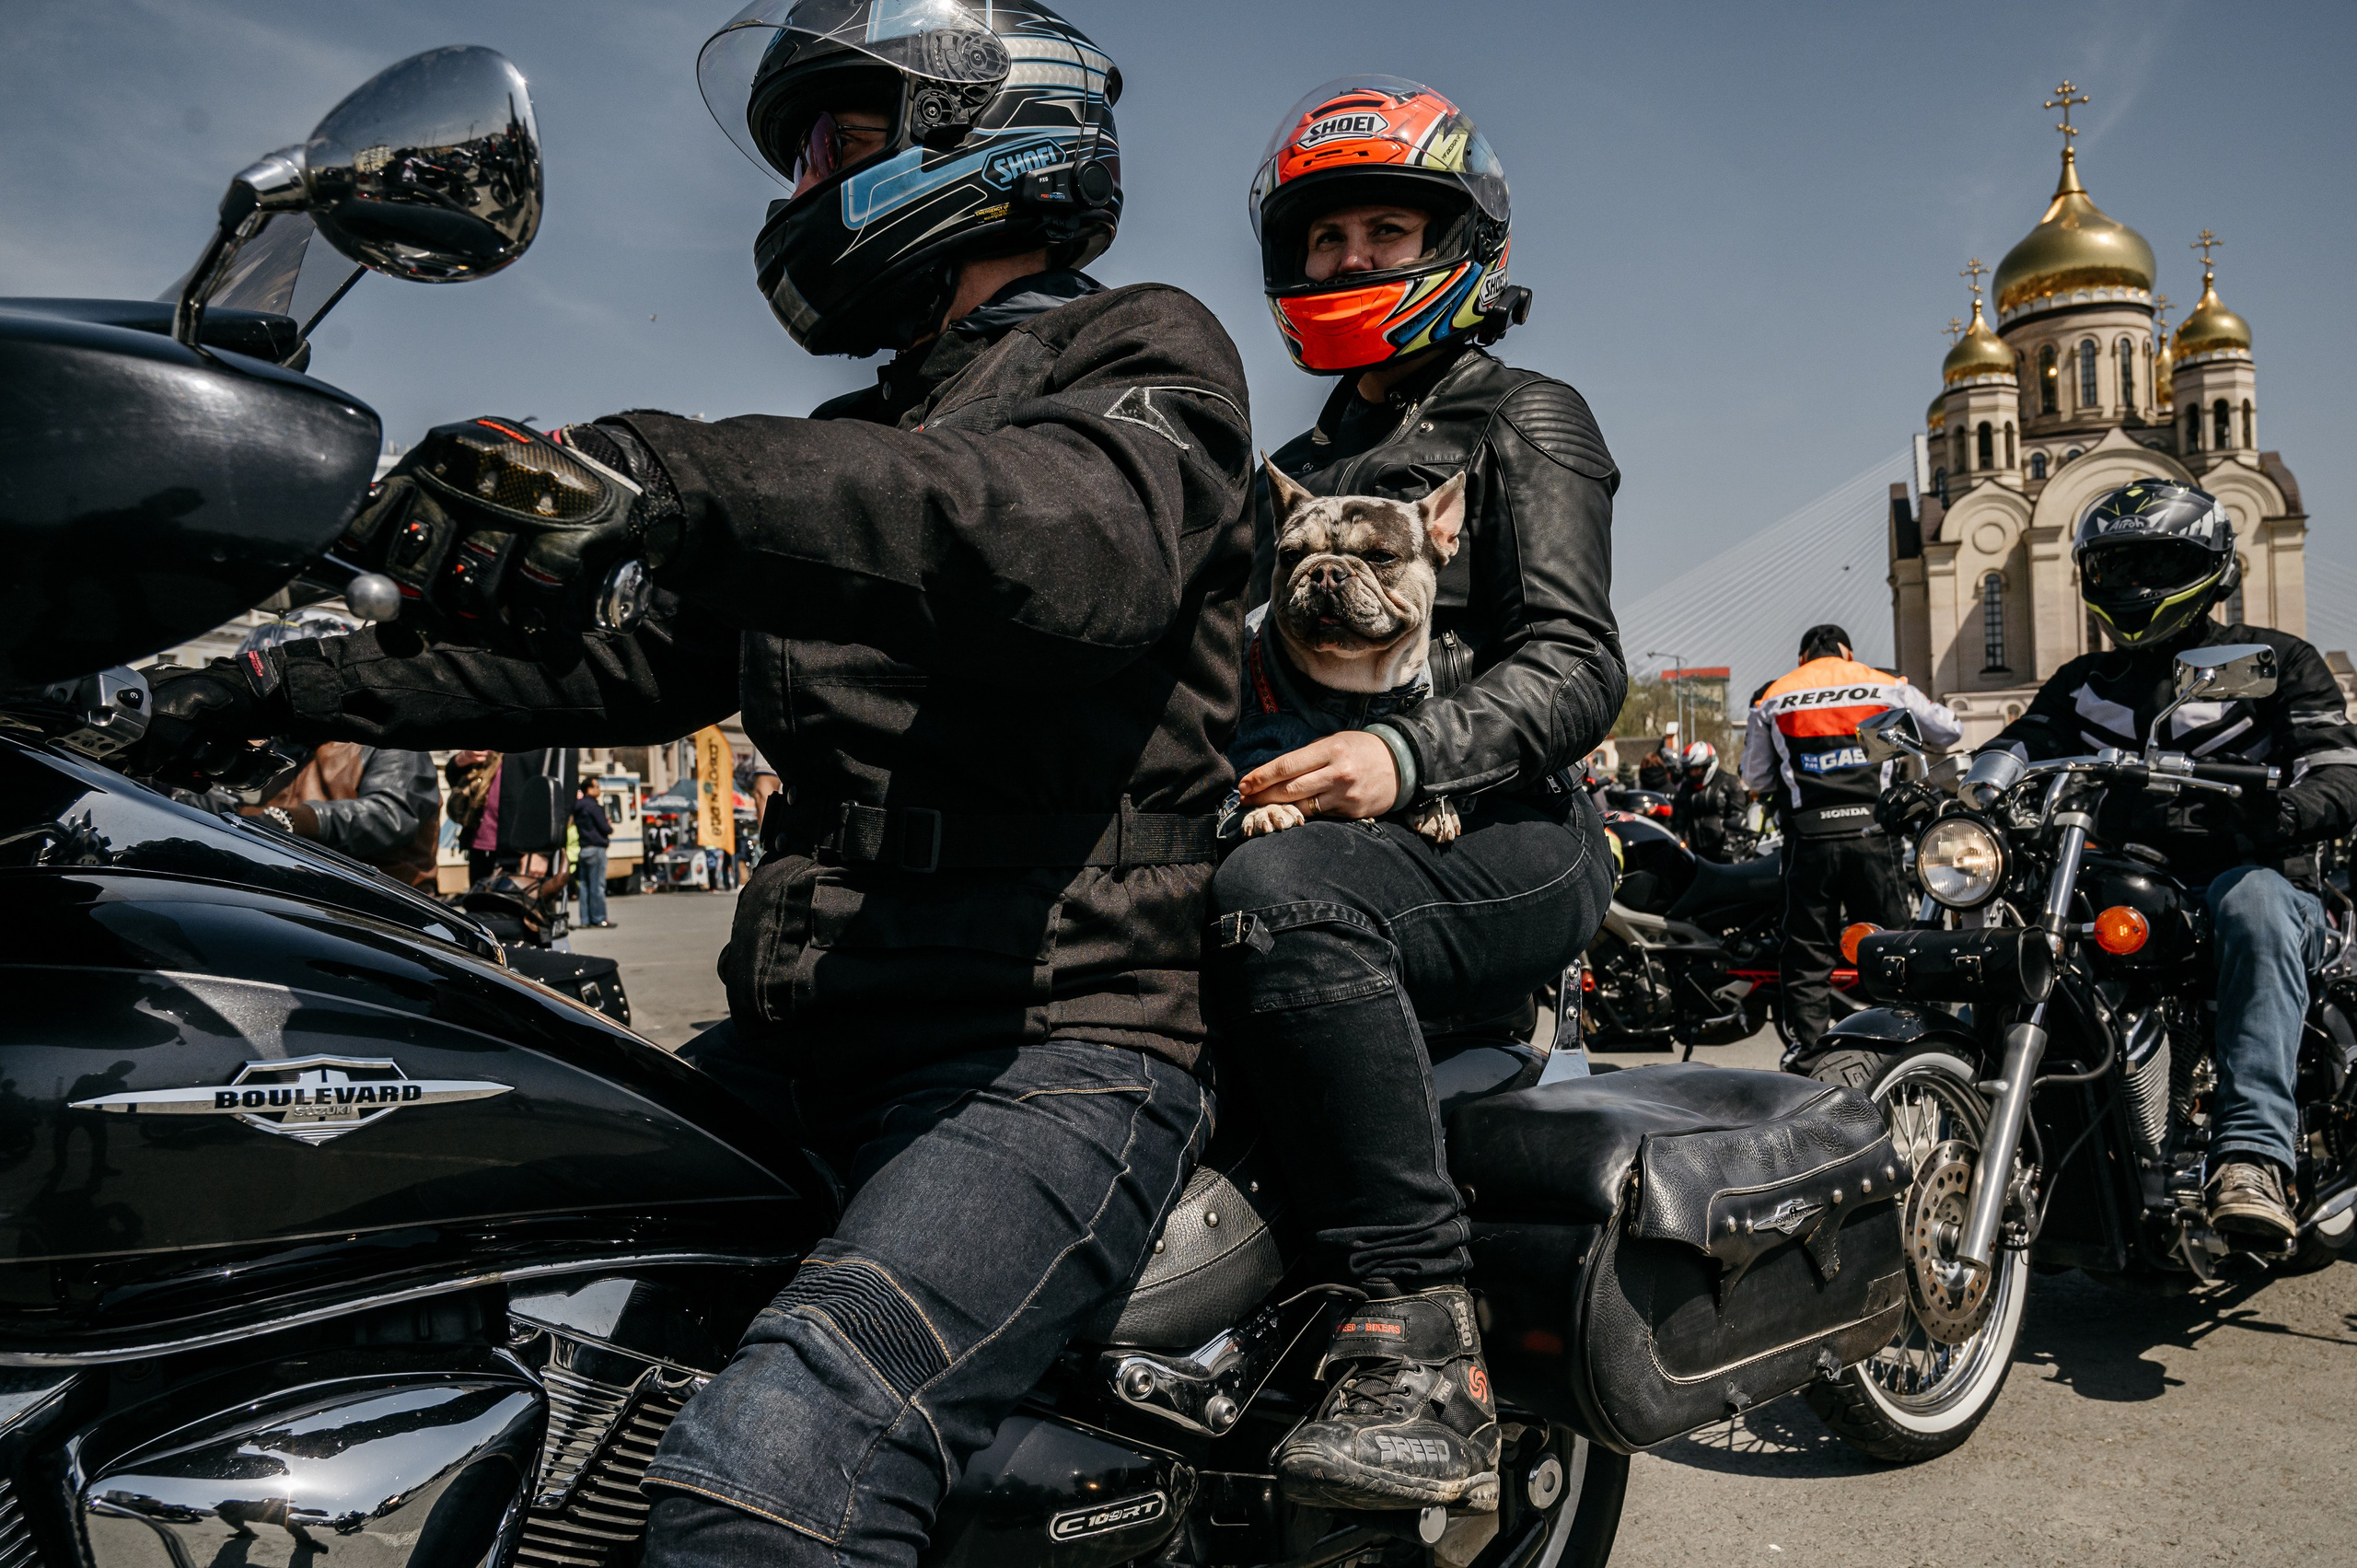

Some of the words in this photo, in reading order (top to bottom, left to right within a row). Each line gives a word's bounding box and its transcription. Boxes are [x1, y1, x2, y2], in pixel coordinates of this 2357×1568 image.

[1308, 116, 1376, 144] SHOEI
[993, 145, 1058, 184] SHOEI
[1484, 273, 1505, 298] SHOE
[2108, 517, 2145, 531] Airoh
[1780, 688, 1881, 709] REPSOL
[1819, 749, 1867, 771] GAS
[1819, 807, 1870, 819] HONDA
[215, 1085, 422, 1109] BOULEVARD
[293, 1106, 353, 1118] SUZUKI
[1365, 1323, 1400, 1334] BIKERS
[1455, 1301, 1473, 1347] PRO
[1436, 1381, 1452, 1402] PRO
[1375, 1435, 1450, 1462] SPEED
